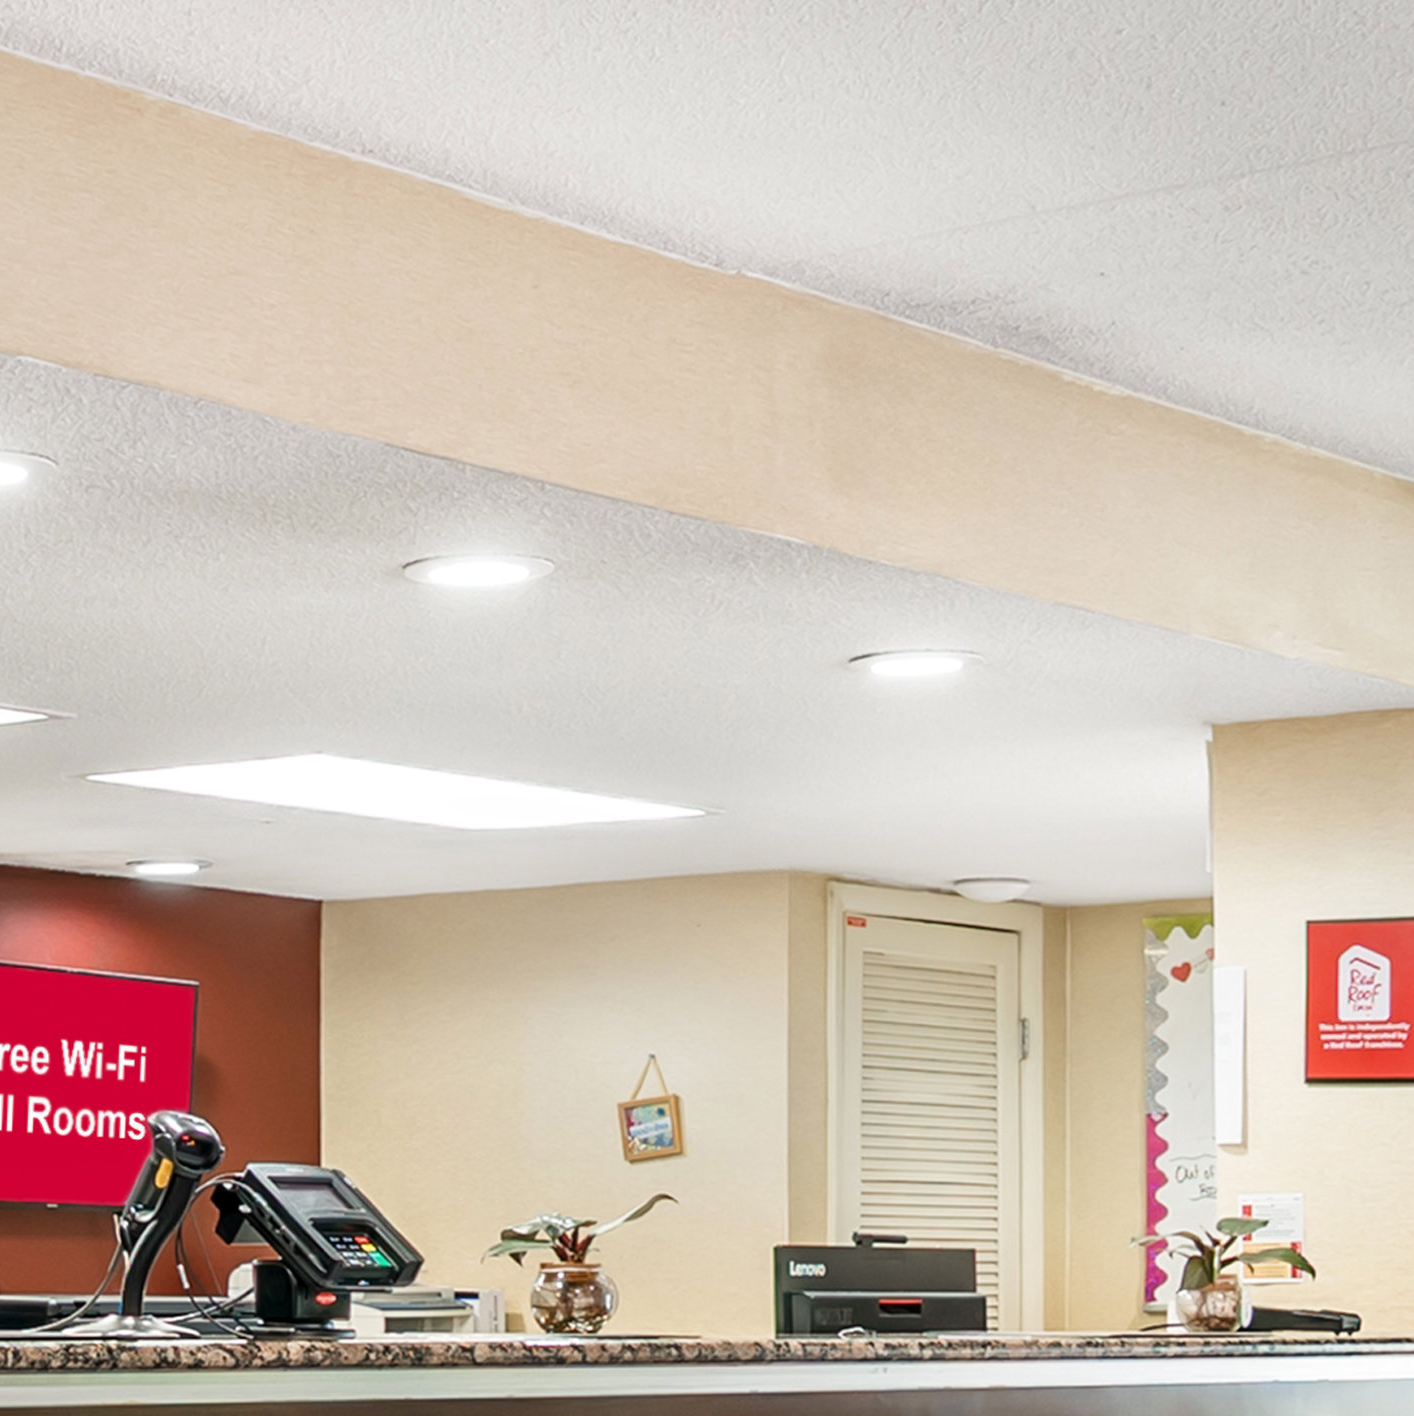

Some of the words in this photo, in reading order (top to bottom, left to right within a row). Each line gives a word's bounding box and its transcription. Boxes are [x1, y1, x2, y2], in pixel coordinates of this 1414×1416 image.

[1350, 968, 1377, 984] Red
[1347, 983, 1382, 1004] Roof
[1356, 1021, 1410, 1032] independently
[60, 1038, 147, 1083] Wi-Fi
[27, 1096, 147, 1141] Rooms
[1175, 1163, 1199, 1184] Out
[789, 1260, 827, 1277] Lenovo
